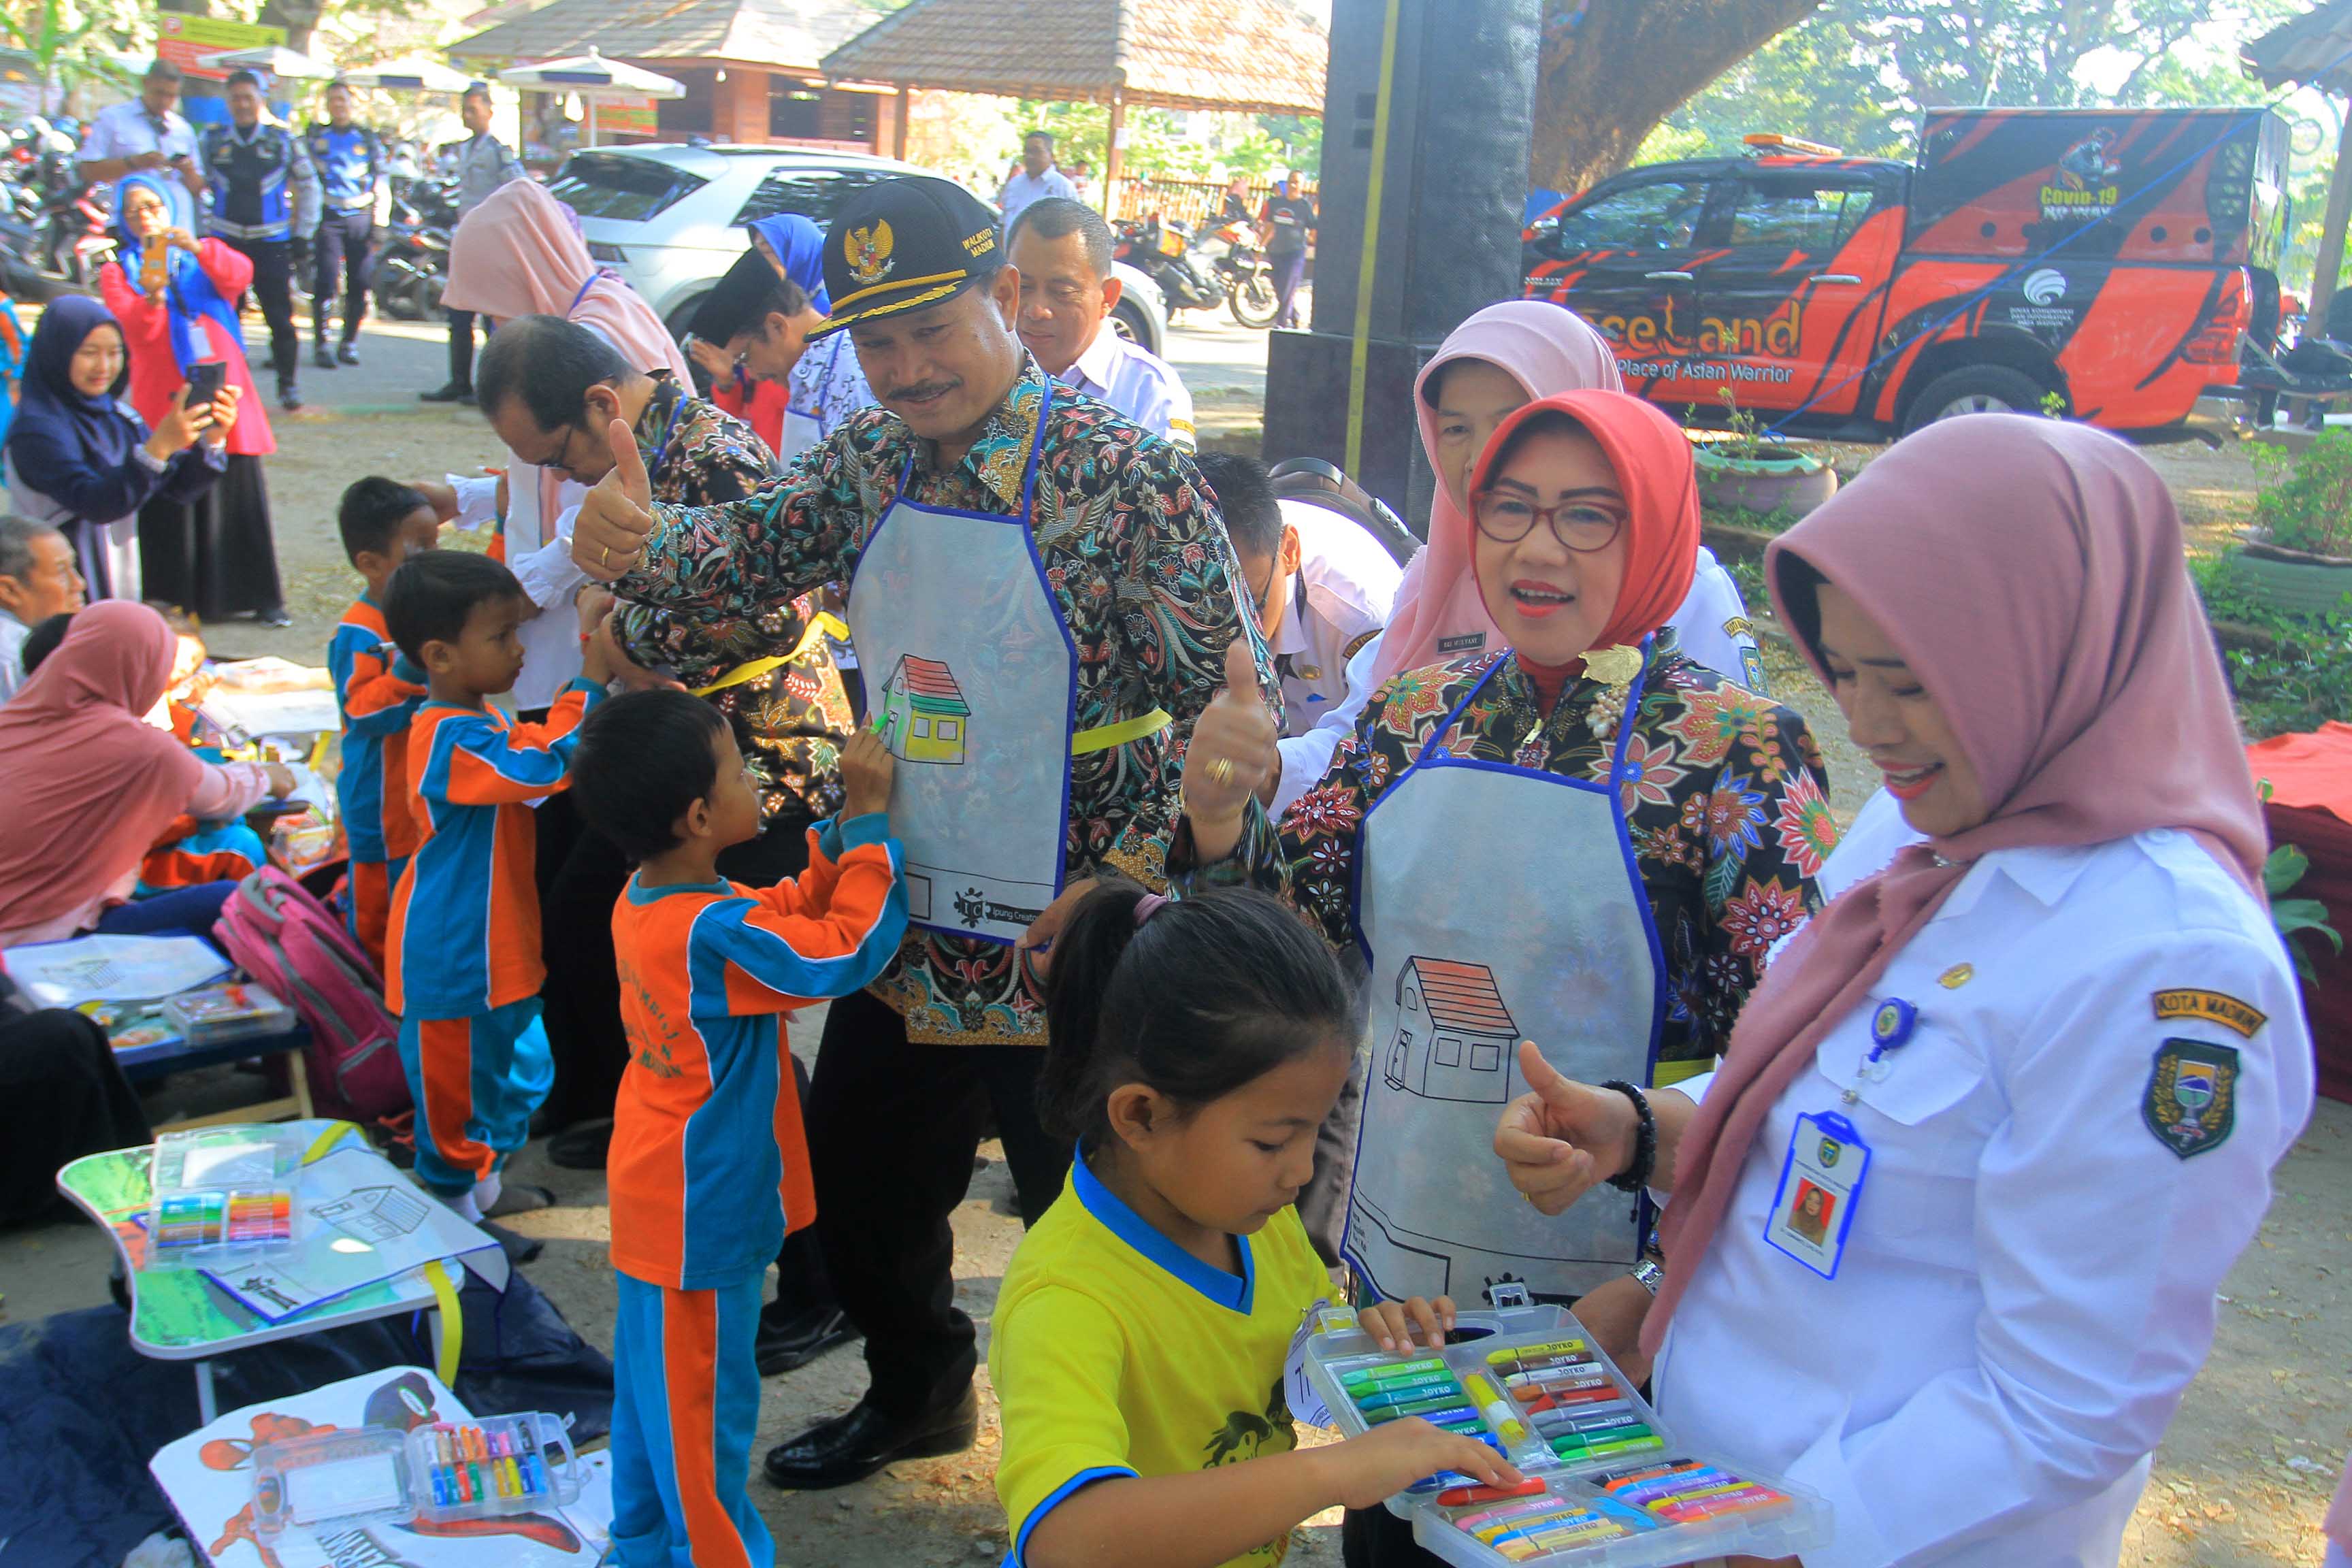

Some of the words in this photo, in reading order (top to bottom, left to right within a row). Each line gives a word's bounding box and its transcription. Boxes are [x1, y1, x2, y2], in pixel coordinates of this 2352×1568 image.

[1618, 359, 1659, 377] Place
[1663, 360, 1680, 381] of
[1682, 362, 1726, 380] Asian
[1729, 363, 1794, 383] Warrior
[992, 906, 1013, 919] Ipung
[1014, 910, 1040, 922] Creato
[2157, 994, 2198, 1011] KOTA
[2206, 996, 2258, 1026] MADIUN
[1546, 1341, 1574, 1351] JOYKO
[1549, 1353, 1578, 1363] JOYKO
[1404, 1361, 1433, 1371] JOYKO
[1557, 1365, 1586, 1376] JOYKO
[1412, 1374, 1441, 1384] JOYKO
[1574, 1377, 1603, 1388] JOYKO
[1422, 1385, 1452, 1395] JOYKO
[1604, 1416, 1633, 1426] JOYKO
